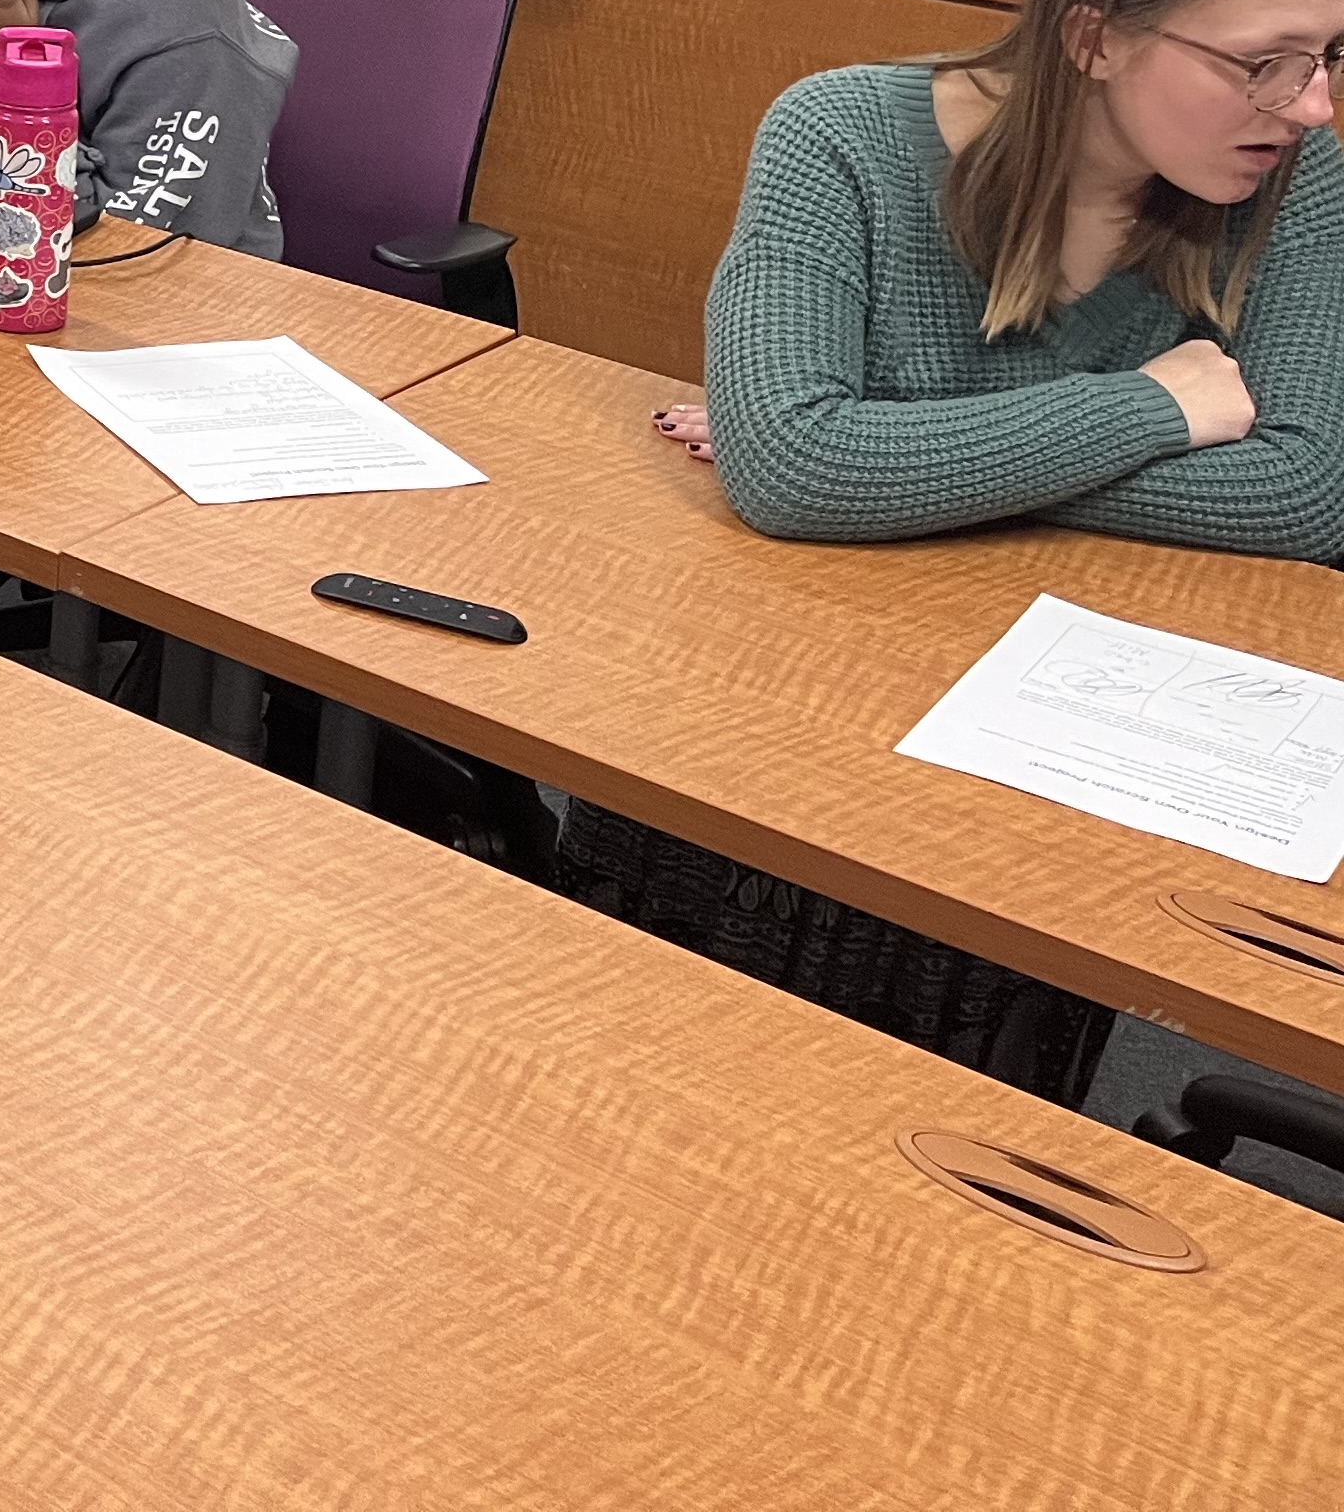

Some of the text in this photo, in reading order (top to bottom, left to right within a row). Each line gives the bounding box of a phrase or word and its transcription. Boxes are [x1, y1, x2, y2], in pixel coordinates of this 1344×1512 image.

[101, 111, 182, 213] TSUNA
[135, 110, 219, 228] SAL
[1091, 780, 1149, 802] Scratch
[1155, 800, 1190, 815] Own
[1192, 813, 1229, 827] Your
[1235, 824, 1290, 846] Design
